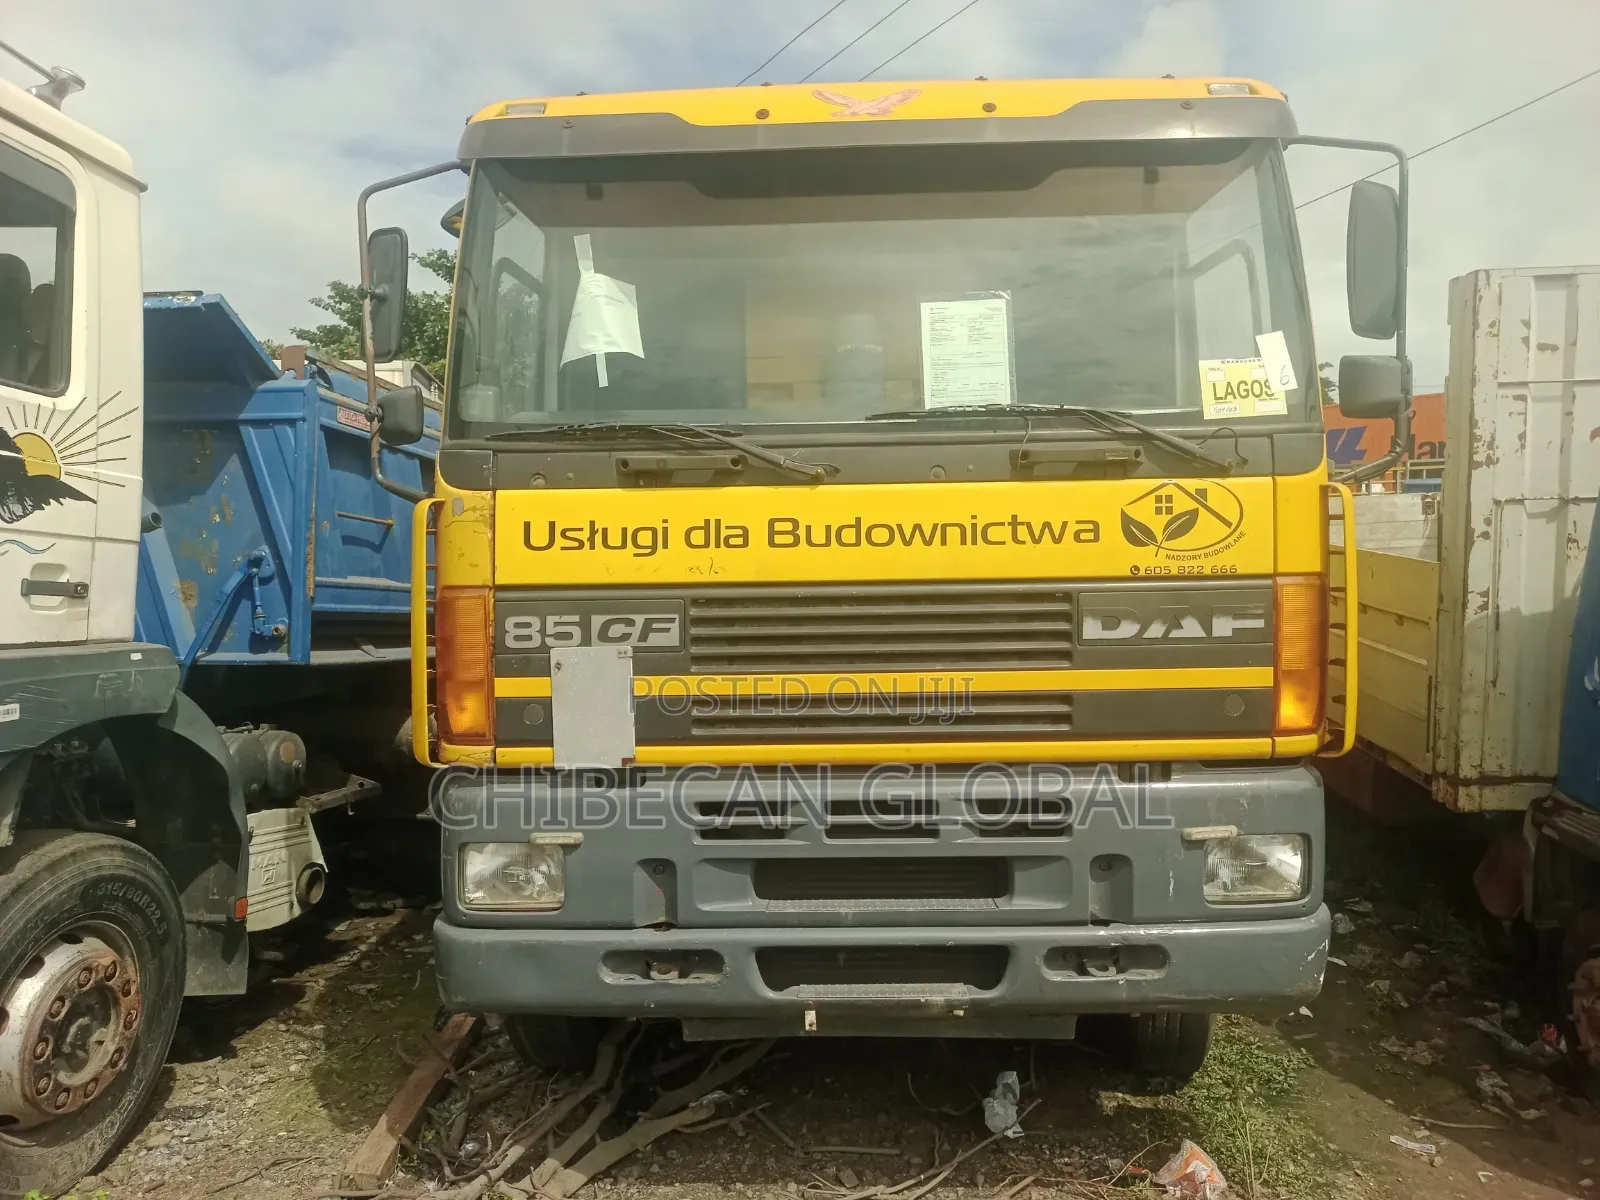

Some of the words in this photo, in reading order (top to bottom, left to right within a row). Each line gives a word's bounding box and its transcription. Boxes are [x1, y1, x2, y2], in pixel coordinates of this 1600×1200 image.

[1280, 364, 1290, 386] 6
[523, 519, 669, 557] Usługi
[684, 518, 750, 549] dla
[767, 514, 1101, 548] Budownictwa
[1165, 553, 1202, 562] NADZORY
[1203, 531, 1246, 559] BUDOWLANE
[1144, 565, 1172, 575] 605
[1177, 565, 1205, 575] 822
[1210, 564, 1238, 574] 666
[504, 615, 582, 649] 85
[596, 617, 677, 644] CF
[1082, 604, 1266, 640] DAF
